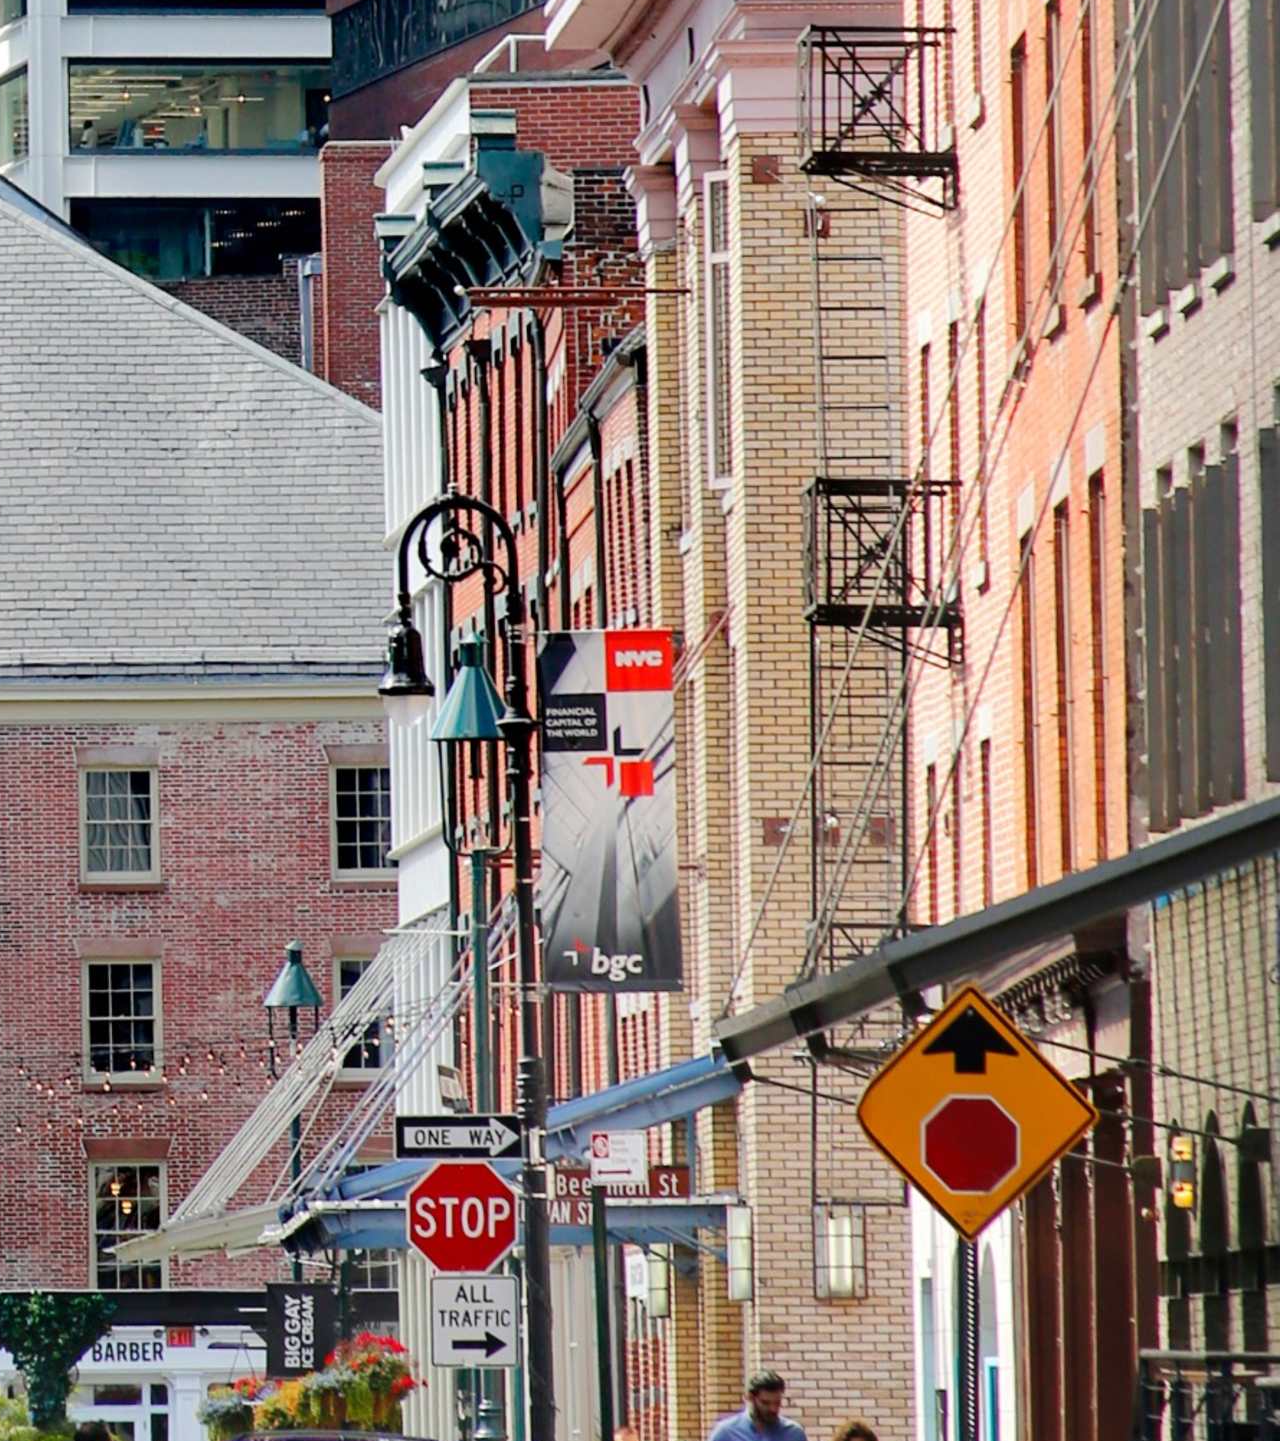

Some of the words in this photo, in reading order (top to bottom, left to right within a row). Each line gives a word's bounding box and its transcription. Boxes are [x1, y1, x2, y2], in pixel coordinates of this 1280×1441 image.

[615, 650, 663, 668] NYC
[545, 707, 596, 717] FINANCIAL
[545, 718, 582, 727] CAPITAL
[584, 718, 597, 726] OF
[546, 729, 564, 738] THE
[564, 729, 598, 737] WORLD
[591, 947, 643, 982] bgc
[414, 1129, 451, 1146] ONE
[469, 1129, 506, 1145] WAY
[557, 1174, 650, 1197] Beeman
[659, 1174, 679, 1197] St
[414, 1197, 510, 1239] STOP
[454, 1285, 494, 1303] ALL
[284, 1294, 301, 1334] GAY
[301, 1295, 315, 1345] CREAM
[439, 1309, 511, 1328] TRAFFIC
[92, 1342, 164, 1362] BARBER
[284, 1336, 301, 1369] BIG
[301, 1347, 315, 1369] ICE
